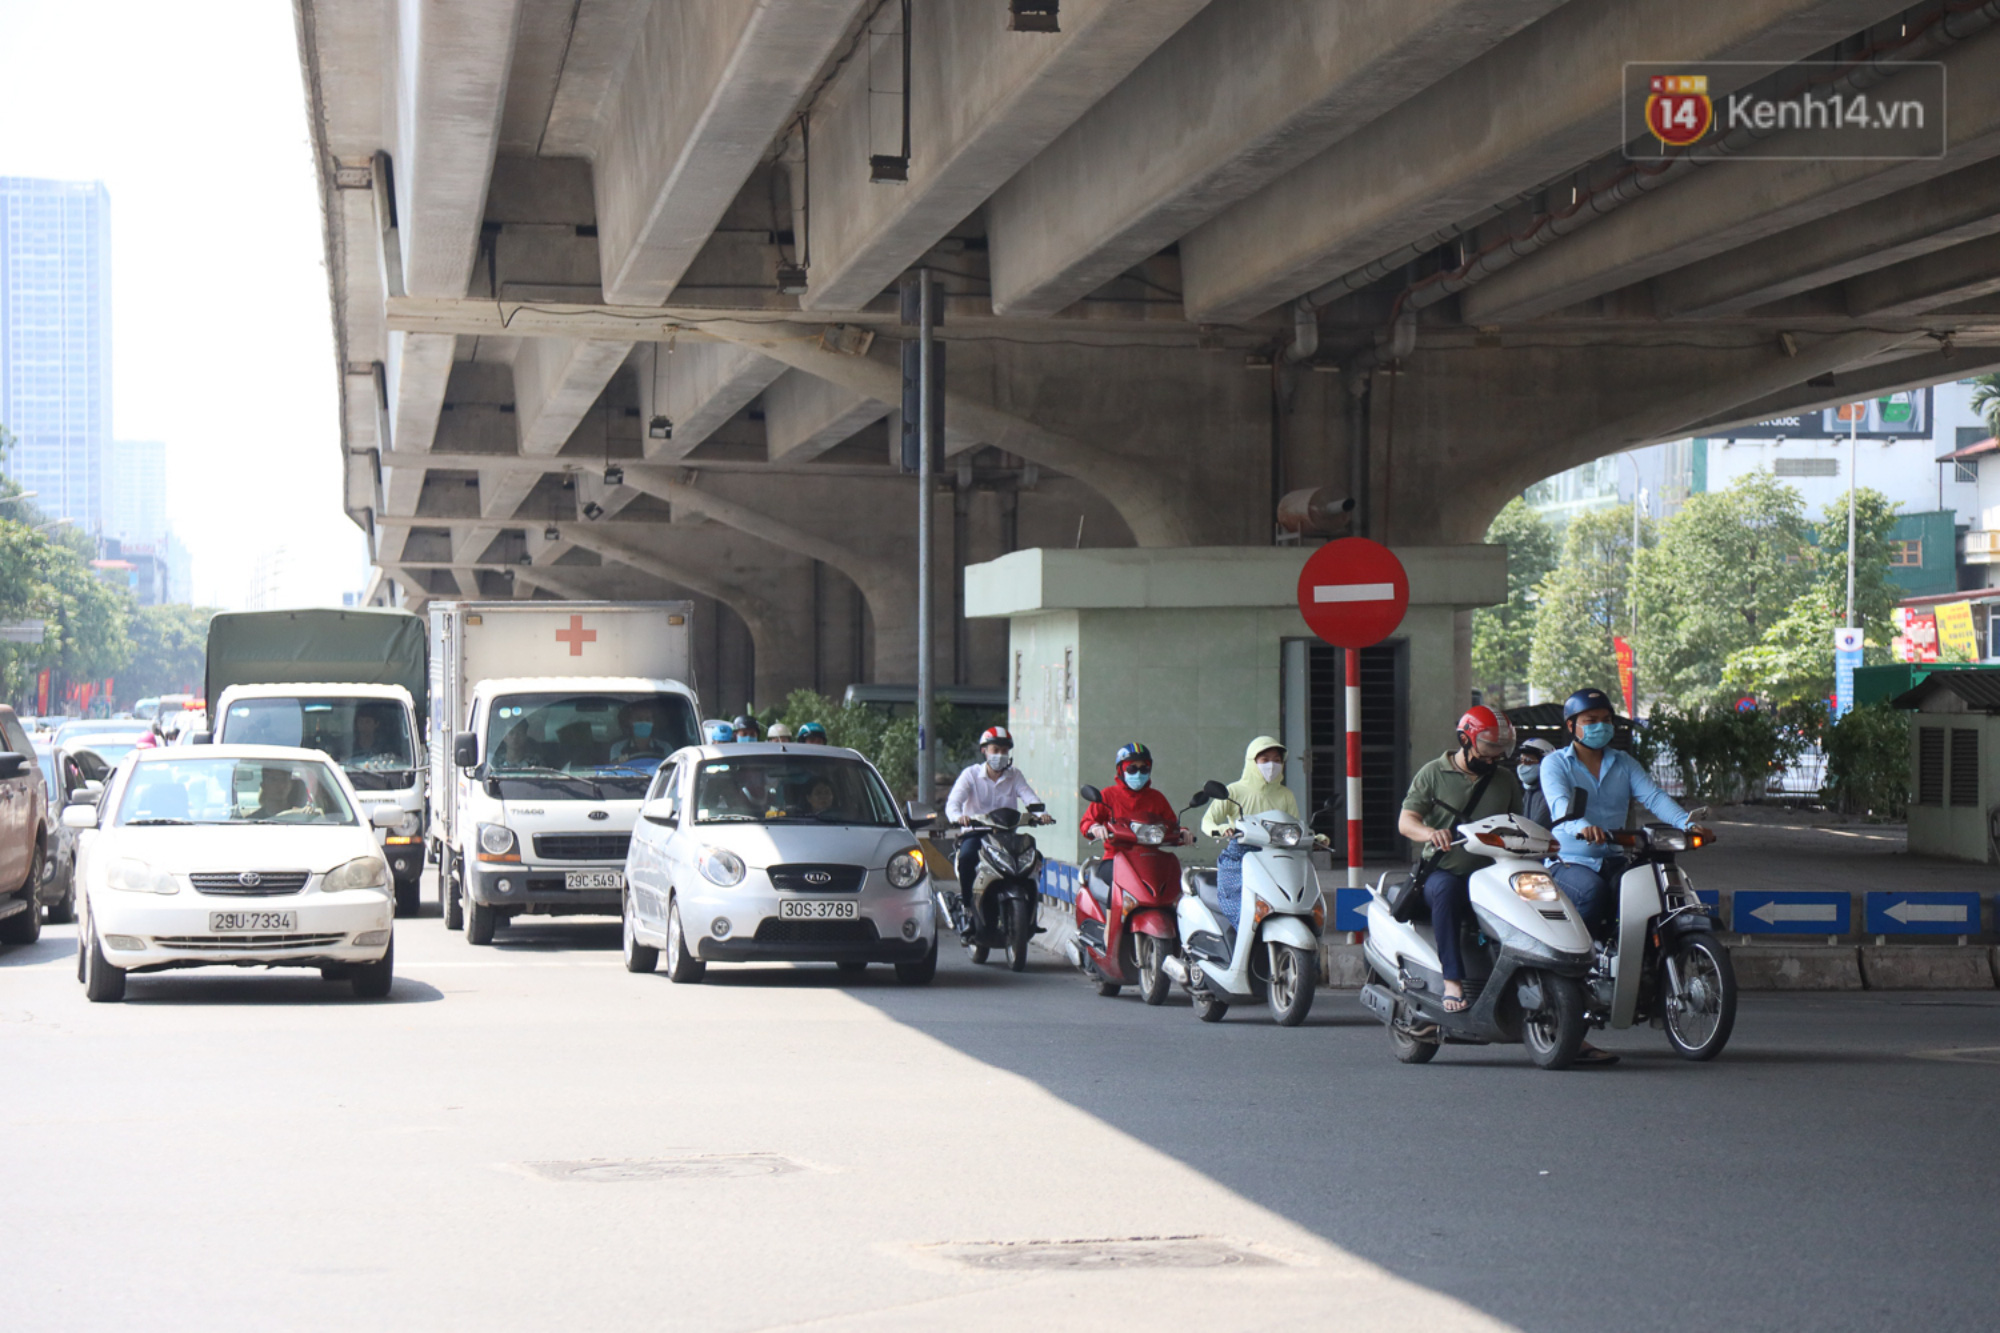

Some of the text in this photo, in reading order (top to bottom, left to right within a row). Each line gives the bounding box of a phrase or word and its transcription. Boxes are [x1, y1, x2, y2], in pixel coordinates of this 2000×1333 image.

[805, 872, 831, 884] KIA
[785, 902, 854, 917] 30S-3789
[215, 913, 290, 929] 29U-7334
